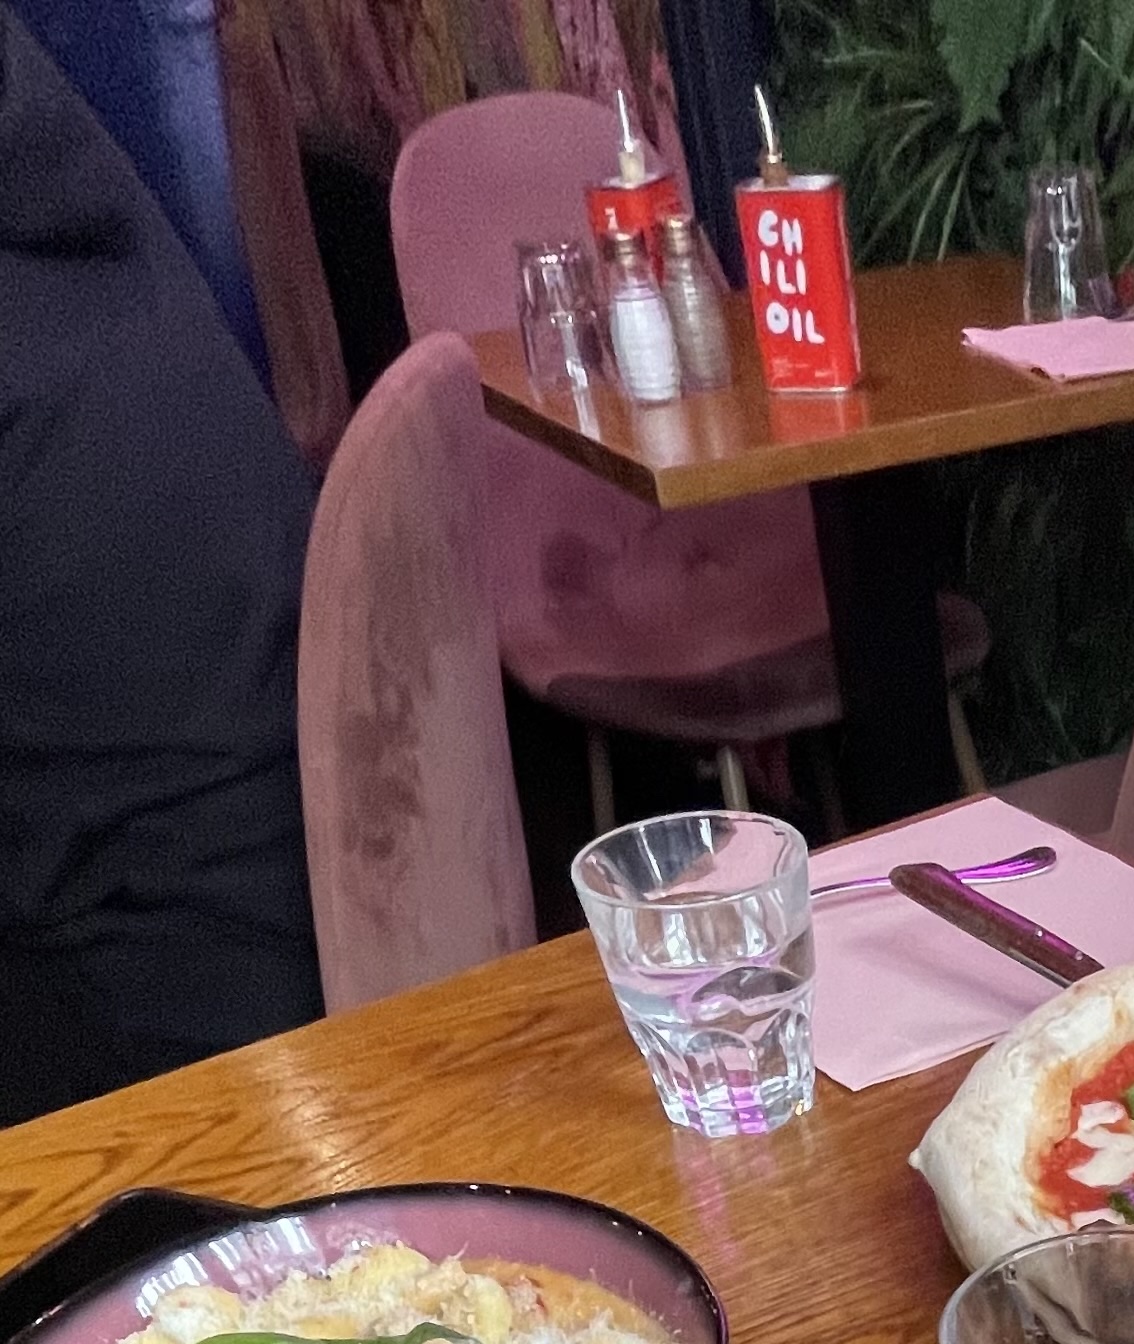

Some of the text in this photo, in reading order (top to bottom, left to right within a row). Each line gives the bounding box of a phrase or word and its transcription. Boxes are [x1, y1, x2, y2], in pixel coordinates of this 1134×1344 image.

[757, 209, 803, 256] CH
[759, 250, 807, 295] ILI
[766, 302, 826, 344] OIL
